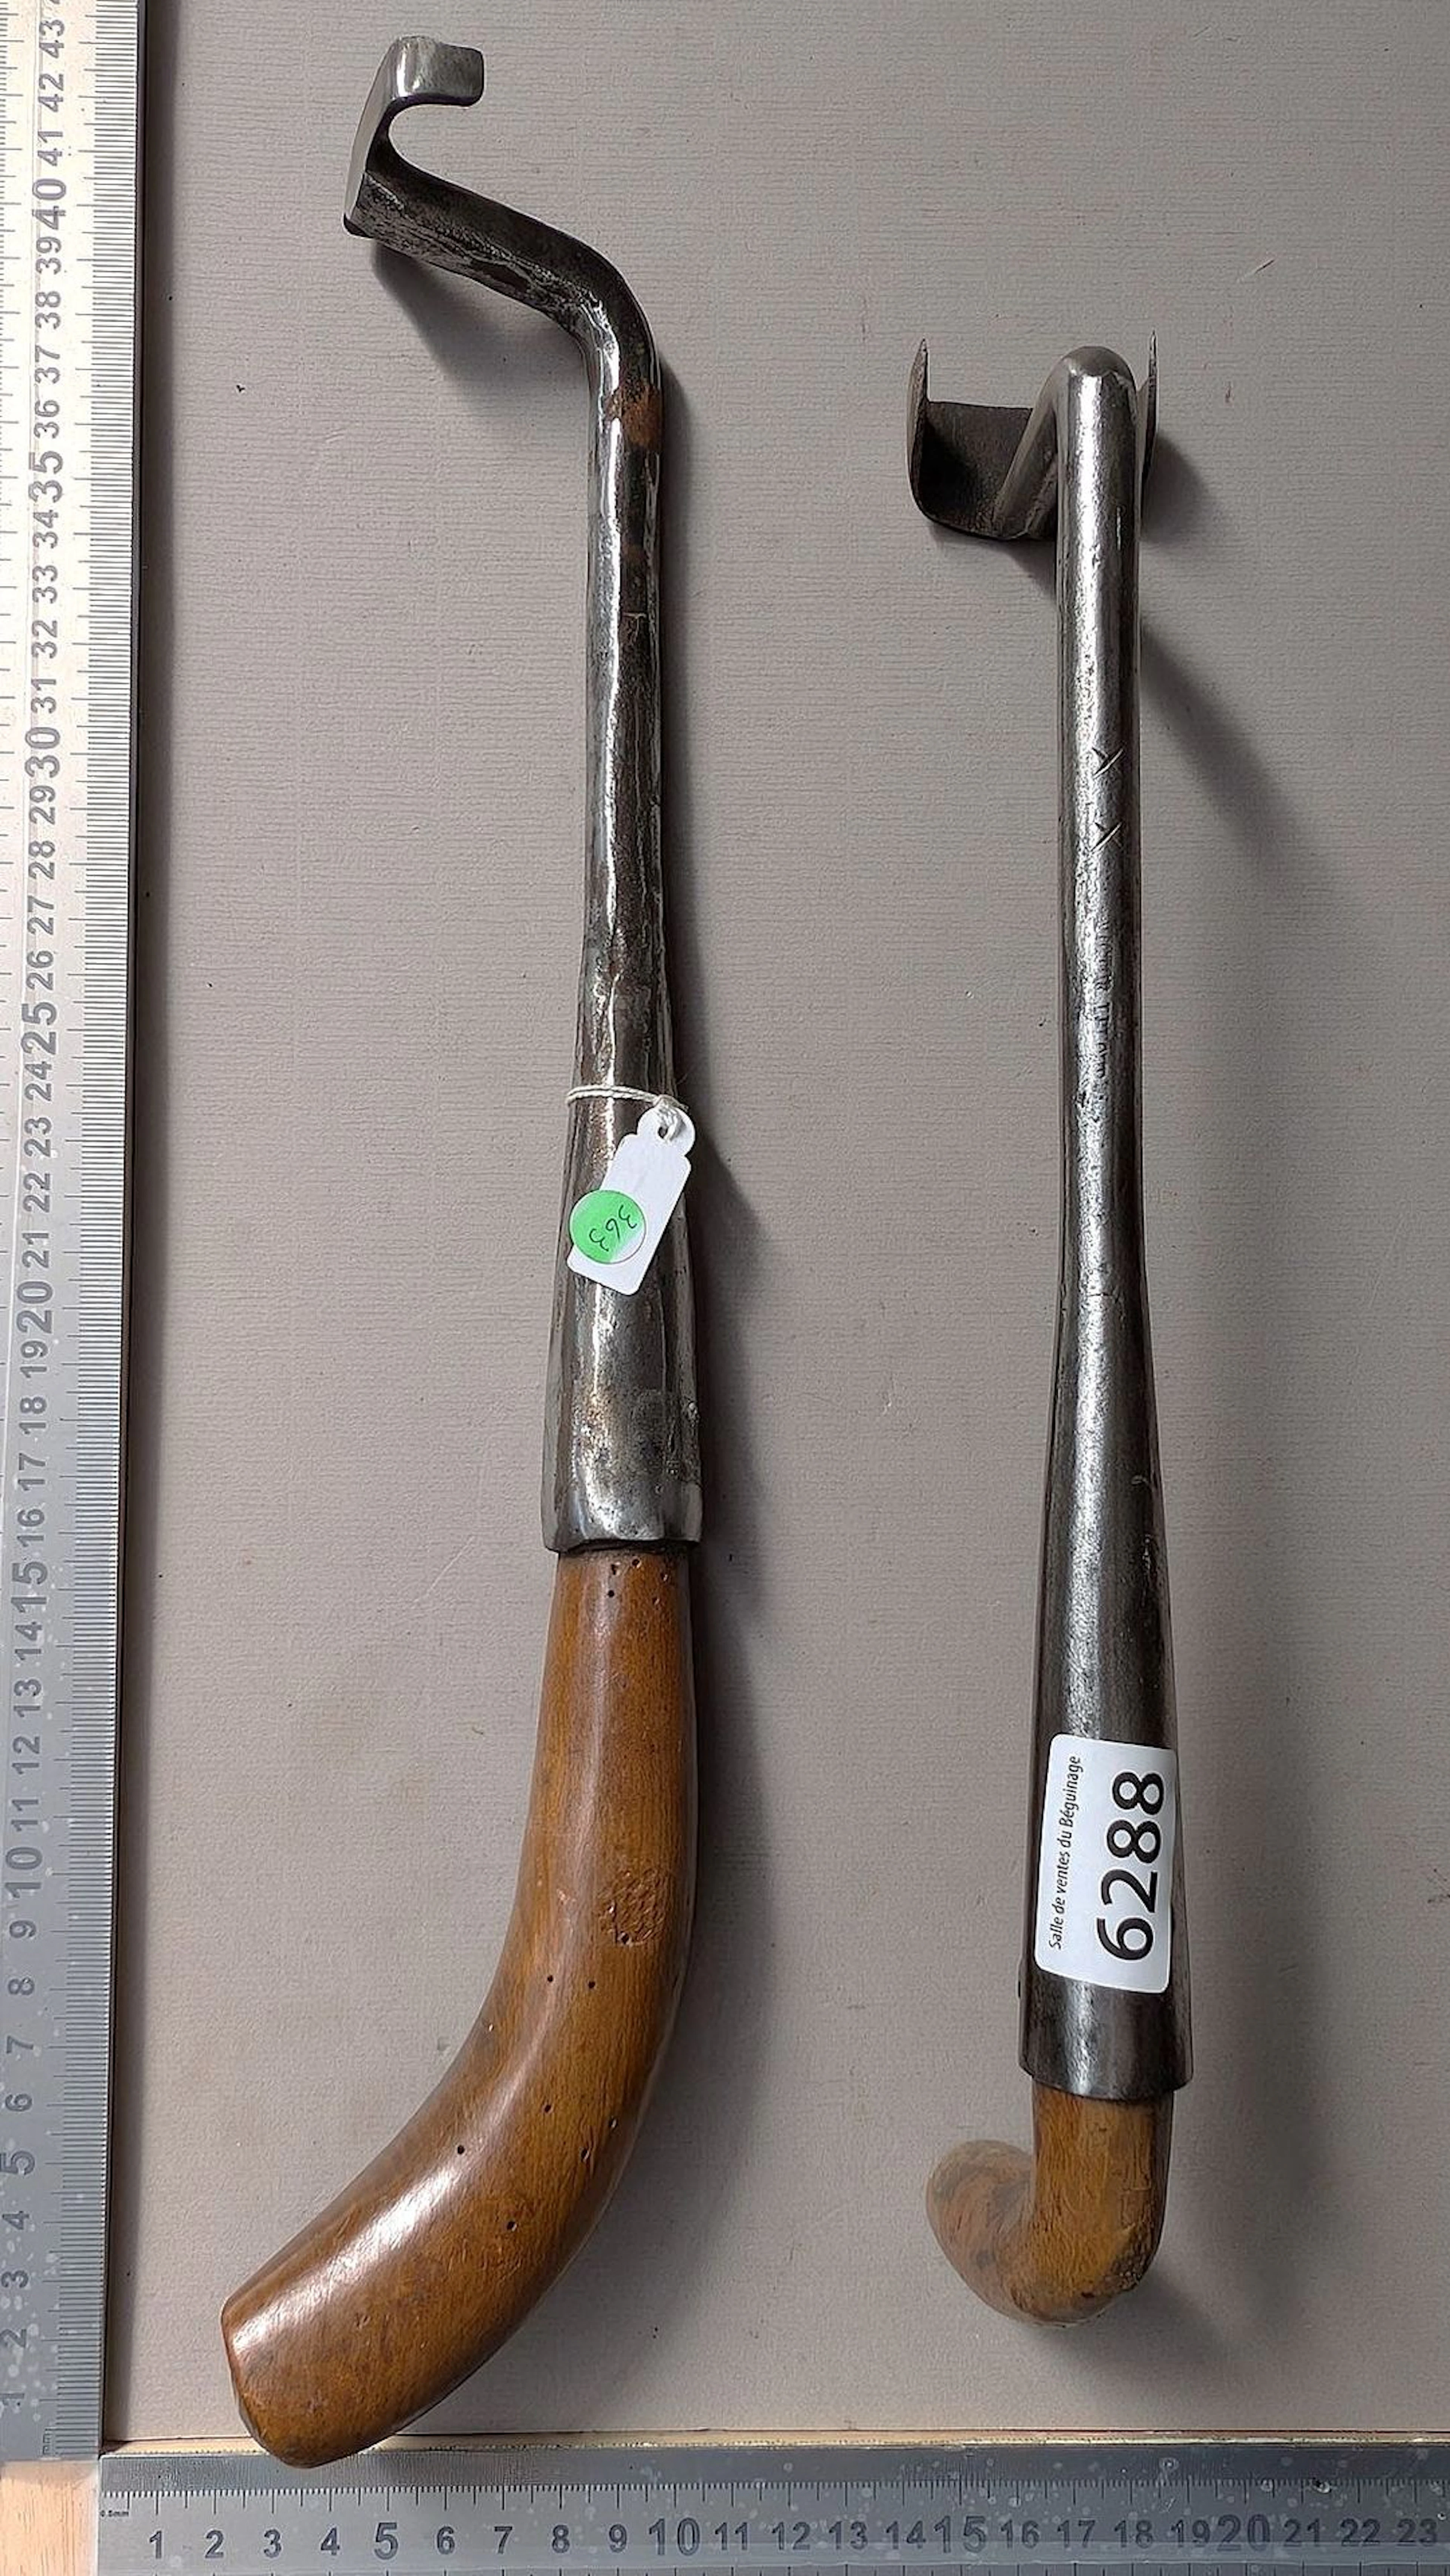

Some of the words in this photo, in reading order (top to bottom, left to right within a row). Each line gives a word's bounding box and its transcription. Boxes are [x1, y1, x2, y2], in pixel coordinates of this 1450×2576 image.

[39, 20, 65, 59] 43
[38, 73, 64, 113] 42
[37, 129, 63, 166] 41
[32, 179, 66, 230] 40
[35, 235, 62, 275] 39
[35, 291, 61, 330] 38
[34, 346, 61, 384] 37
[34, 400, 60, 439] 36
[28, 451, 63, 503] 35
[32, 510, 59, 549] 34
[32, 565, 58, 607] 33
[31, 620, 57, 659] 32
[31, 678, 57, 713] 31
[24, 727, 60, 778] 30
[29, 786, 56, 825] 29
[28, 840, 56, 880] 28
[27, 895, 54, 935] 27
[26, 951, 53, 990] 26
[20, 1002, 57, 1055] 25
[24, 1061, 52, 1101] 24
[23, 1118, 51, 1157] 23
[23, 1173, 50, 1212] 22
[22, 1233, 49, 1268] 21
[16, 1282, 52, 1333] 20
[20, 1341, 48, 1378] 19
[19, 1397, 46, 1435] 18
[18, 1453, 45, 1491] 17
[17, 1509, 44, 1547] 16
[11, 1562, 48, 1612] 15
[15, 1622, 42, 1660] 14
[14, 1679, 41, 1717] 13
[12, 1737, 40, 1774] 12
[1059, 1756, 1083, 1827] Béguinage
[11, 1799, 38, 1832] 11
[1057, 1831, 1072, 1847] du
[5, 1847, 42, 1898] 10
[1057, 1852, 1070, 1893] ventes
[1097, 1772, 1165, 1960] 6288
[1052, 1897, 1065, 1914] de
[9, 1921, 36, 1938] 9
[1049, 1917, 1064, 1949] Salle
[8, 1978, 34, 1995] 8
[6, 2036, 33, 2054] 7
[5, 2094, 32, 2111] 6
[0, 2151, 35, 2176] 5
[2, 2211, 29, 2230] 4
[1, 2271, 28, 2288] 3
[0, 2329, 26, 2348] 2
[0, 2393, 25, 2405] 1
[150, 2530, 162, 2559] 1
[205, 2530, 224, 2559] 2
[264, 2529, 282, 2558] 3
[321, 2527, 340, 2556] 4
[375, 2522, 398, 2560] 5
[437, 2526, 455, 2554] 6
[494, 2526, 512, 2554] 7
[552, 2525, 570, 2553] 8
[609, 2524, 627, 2553] 9
[649, 2517, 700, 2556] 10
[715, 2522, 747, 2550] 11
[771, 2522, 811, 2550] 12
[829, 2521, 868, 2550] 13
[886, 2521, 926, 2549] 14
[934, 2515, 986, 2553] 15
[1001, 2520, 1040, 2548] 16
[1058, 2520, 1096, 2548] 17
[1114, 2520, 1154, 2548] 18
[1171, 2519, 1210, 2548] 19
[1217, 2514, 1271, 2551] 20
[1285, 2519, 1321, 2547] 21
[1340, 2518, 1381, 2546] 22
[1397, 2518, 1437, 2547] 23
